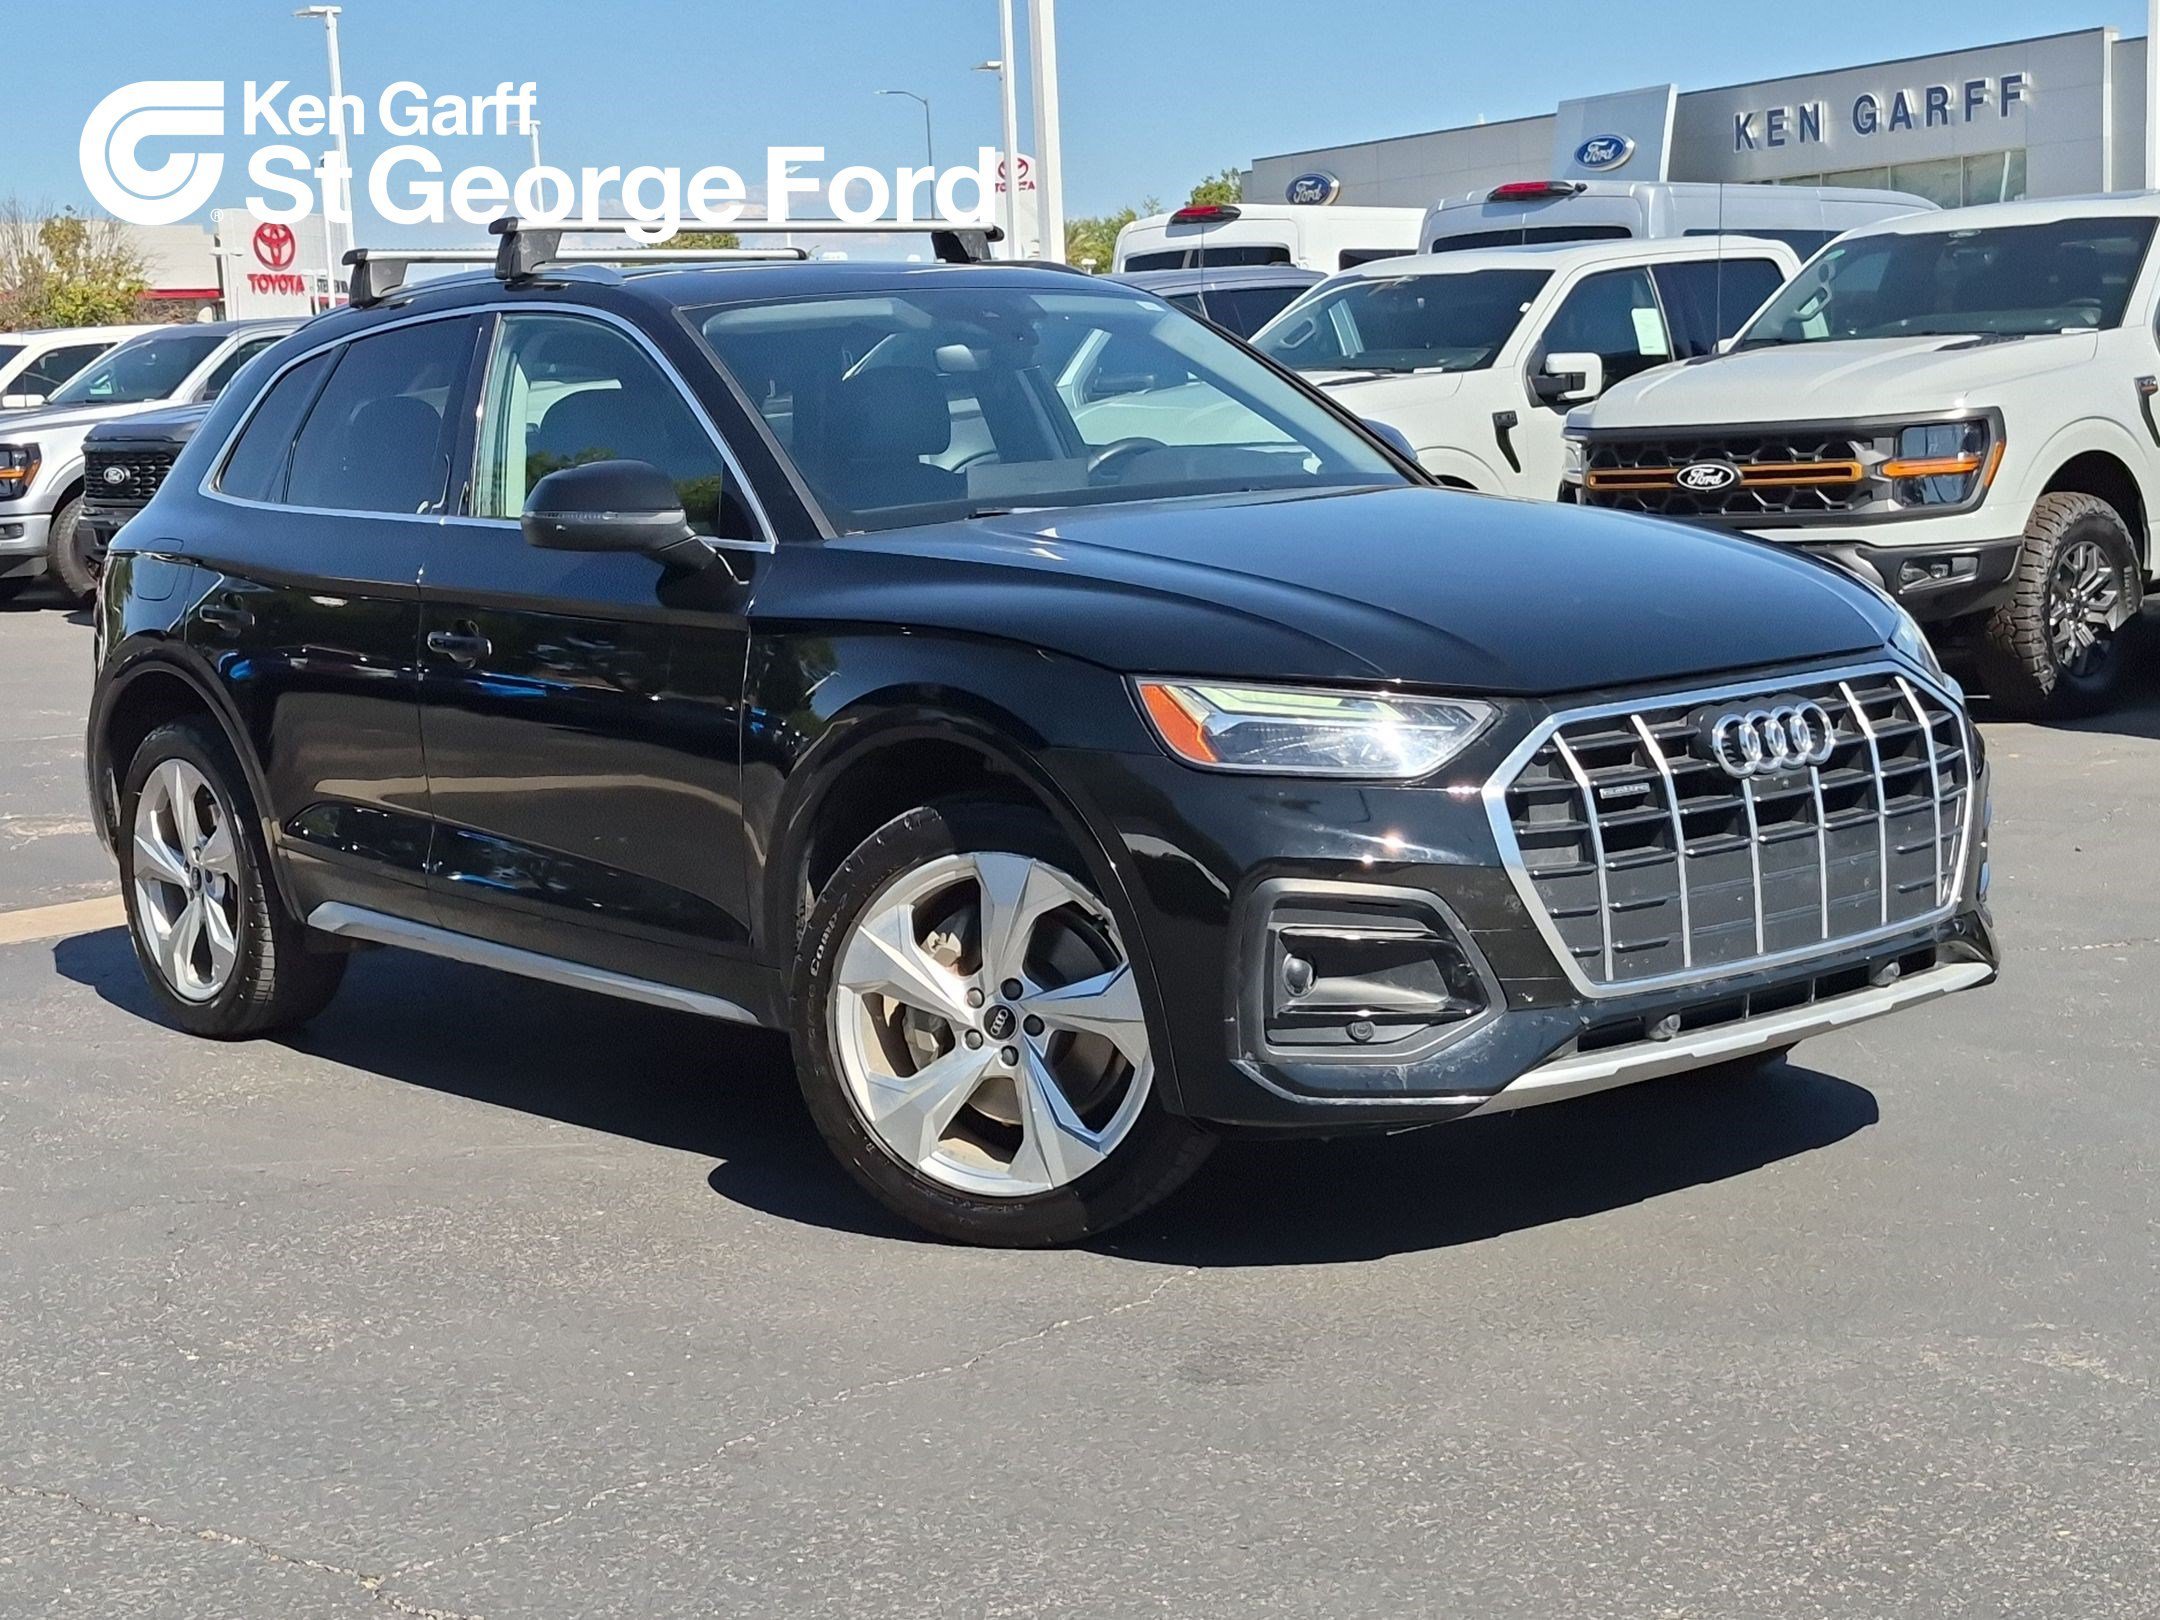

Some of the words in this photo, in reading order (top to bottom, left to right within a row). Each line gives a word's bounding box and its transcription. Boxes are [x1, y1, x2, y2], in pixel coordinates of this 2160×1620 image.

[1734, 101, 1822, 151] KEN
[1852, 74, 2024, 135] GARFF
[1583, 140, 1617, 163] Ford
[1292, 180, 1322, 204] Ford
[247, 273, 306, 295] TOYOTA
[1686, 468, 1725, 485] Ford
